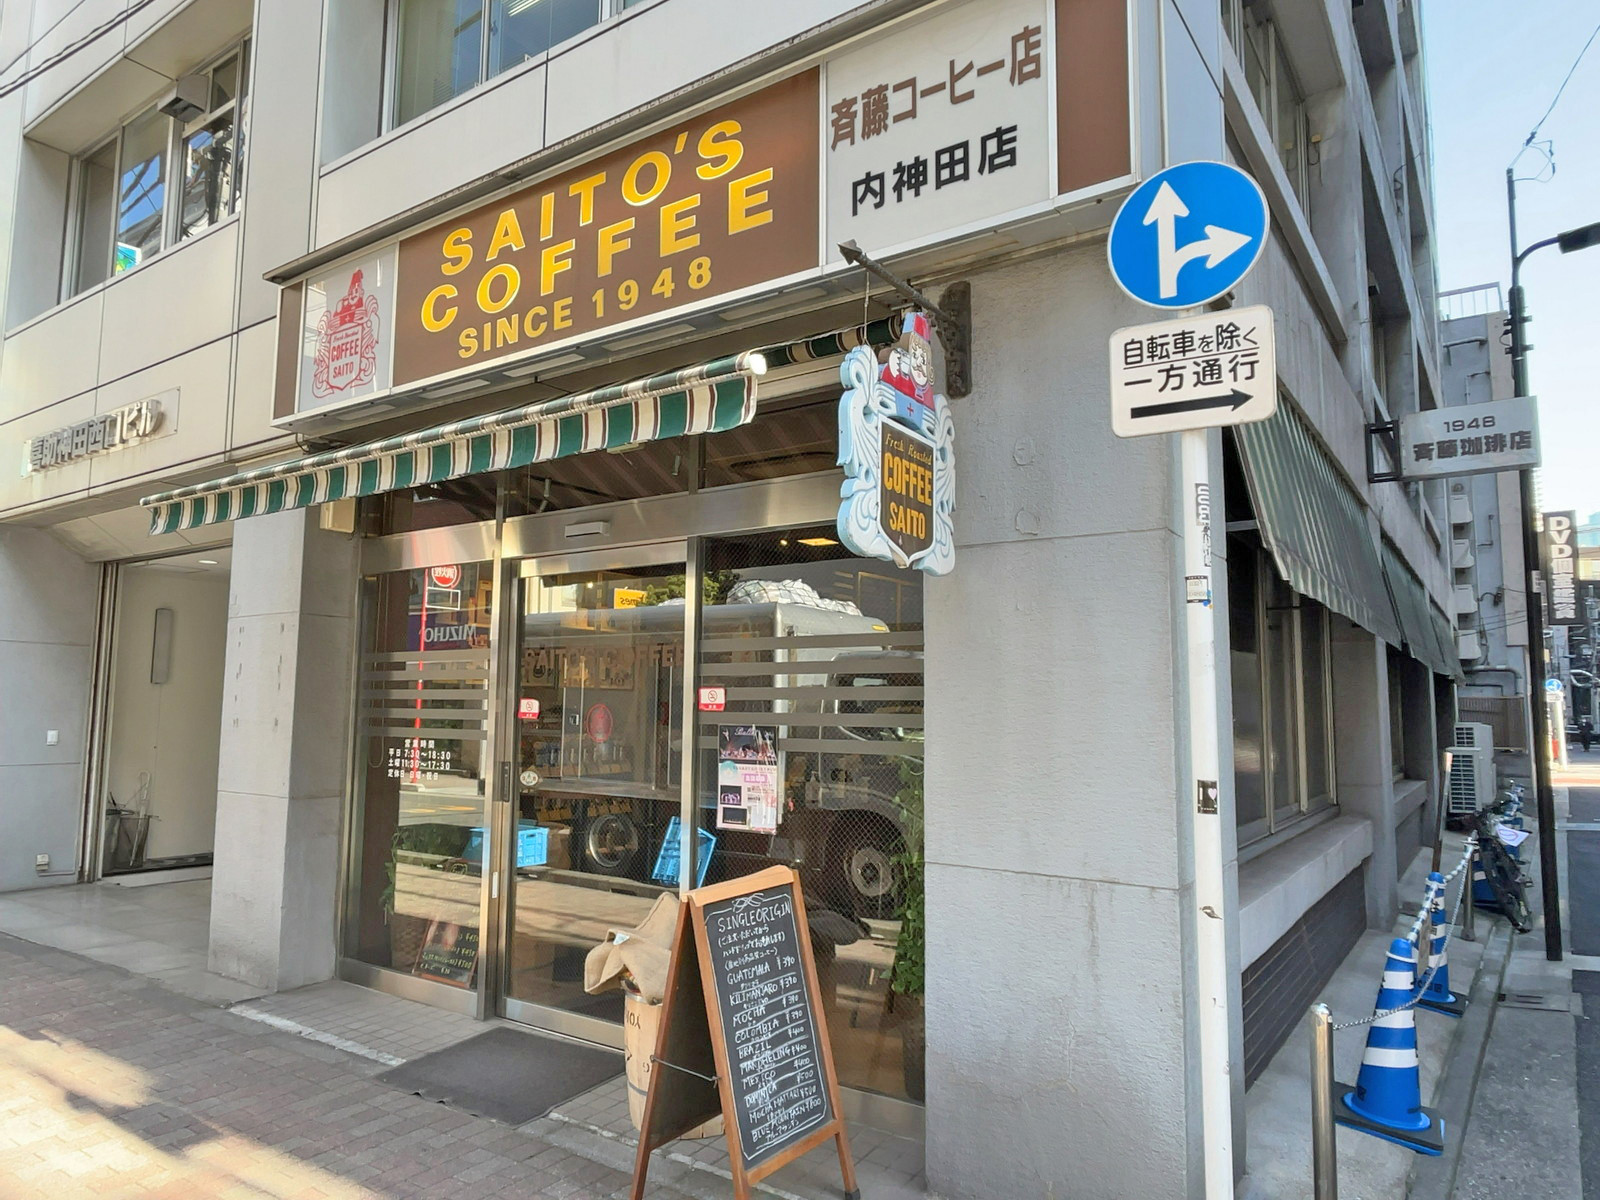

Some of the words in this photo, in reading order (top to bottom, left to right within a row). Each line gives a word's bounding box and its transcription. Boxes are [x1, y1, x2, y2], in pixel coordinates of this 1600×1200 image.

[831, 25, 1042, 152] 斉藤コーヒー店
[852, 124, 1017, 217] 内神田店
[441, 120, 744, 276] SAITO'S
[421, 167, 774, 333] COFFEE
[458, 299, 573, 358] SINCE
[592, 256, 712, 318] 1948
[331, 338, 360, 362] COFFEE
[1124, 322, 1258, 366] 自転車を除く
[332, 361, 354, 379] SAITO
[1124, 352, 1260, 393] 一方通行
[1443, 415, 1496, 433] 1948
[885, 433, 905, 452] Fresh
[884, 452, 933, 507] COFFEE
[889, 501, 926, 540] SAITO
[388, 748, 401, 757] 平日
[404, 739, 435, 749] 営業時間
[388, 759, 400, 767] 土曜
[388, 769, 405, 778] 定休日
[727, 962, 770, 985] GUATEMALA
[729, 983, 778, 1006] KILIMANJARO
[733, 1004, 766, 1027] MOCHA
[738, 1040, 772, 1059] BRAZIL
